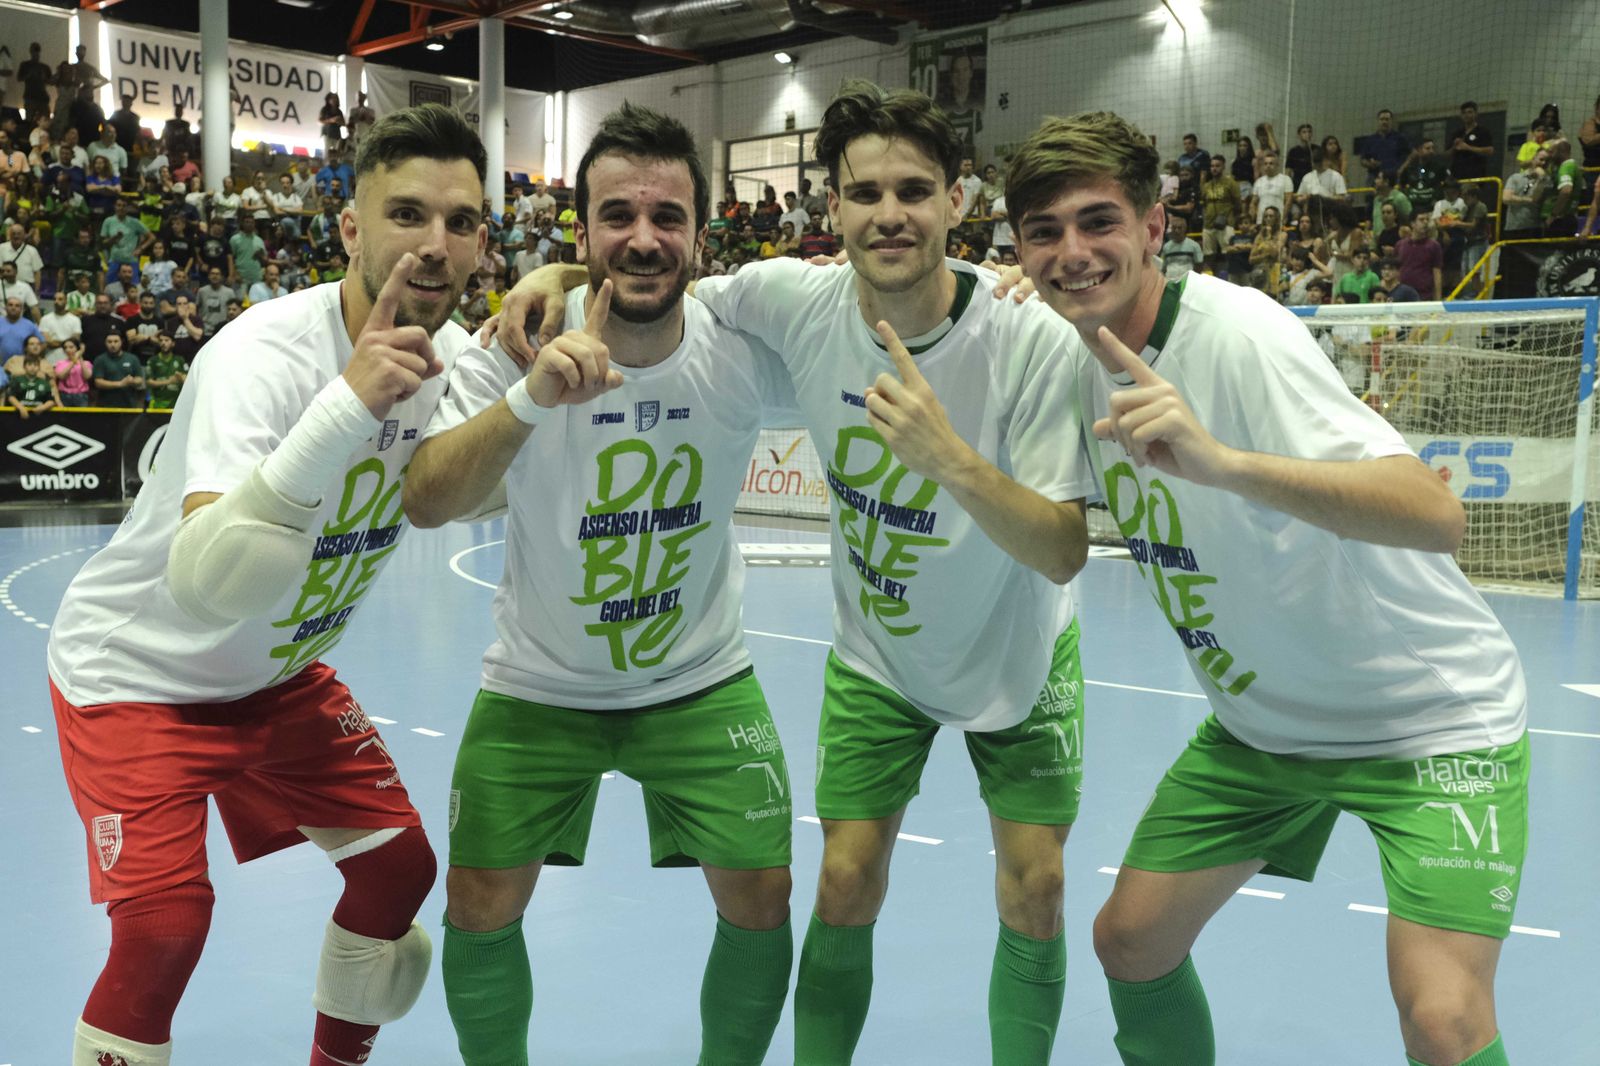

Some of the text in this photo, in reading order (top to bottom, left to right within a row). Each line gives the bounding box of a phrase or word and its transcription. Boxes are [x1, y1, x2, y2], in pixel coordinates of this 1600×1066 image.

[117, 39, 324, 93] UNIVSIDAD
[118, 76, 301, 125] DE MAGA
[592, 412, 625, 425] TEMPORADA
[20, 470, 99, 490] umbro
[585, 438, 703, 516] DO
[741, 459, 803, 495] lcon
[827, 425, 940, 510] DO
[578, 501, 702, 540] ASCENSO A PRIMERA
[866, 498, 876, 519] A
[876, 501, 937, 535] PRIMERA
[1104, 461, 1183, 547] DO
[1151, 542, 1200, 572] PRIMERA
[867, 566, 882, 591] DEL
[884, 578, 907, 602] REY
[600, 587, 681, 623] COPA DEL REY
[1041, 698, 1076, 716] viajes
[1030, 766, 1066, 779] diputación
[1440, 780, 1496, 798] viajes
[99, 820, 115, 832] CLUB
[745, 806, 780, 821] diputación
[1417, 801, 1503, 854] M
[100, 837, 116, 848] UMA
[1419, 857, 1471, 869] diputación
[1474, 858, 1486, 870] de
